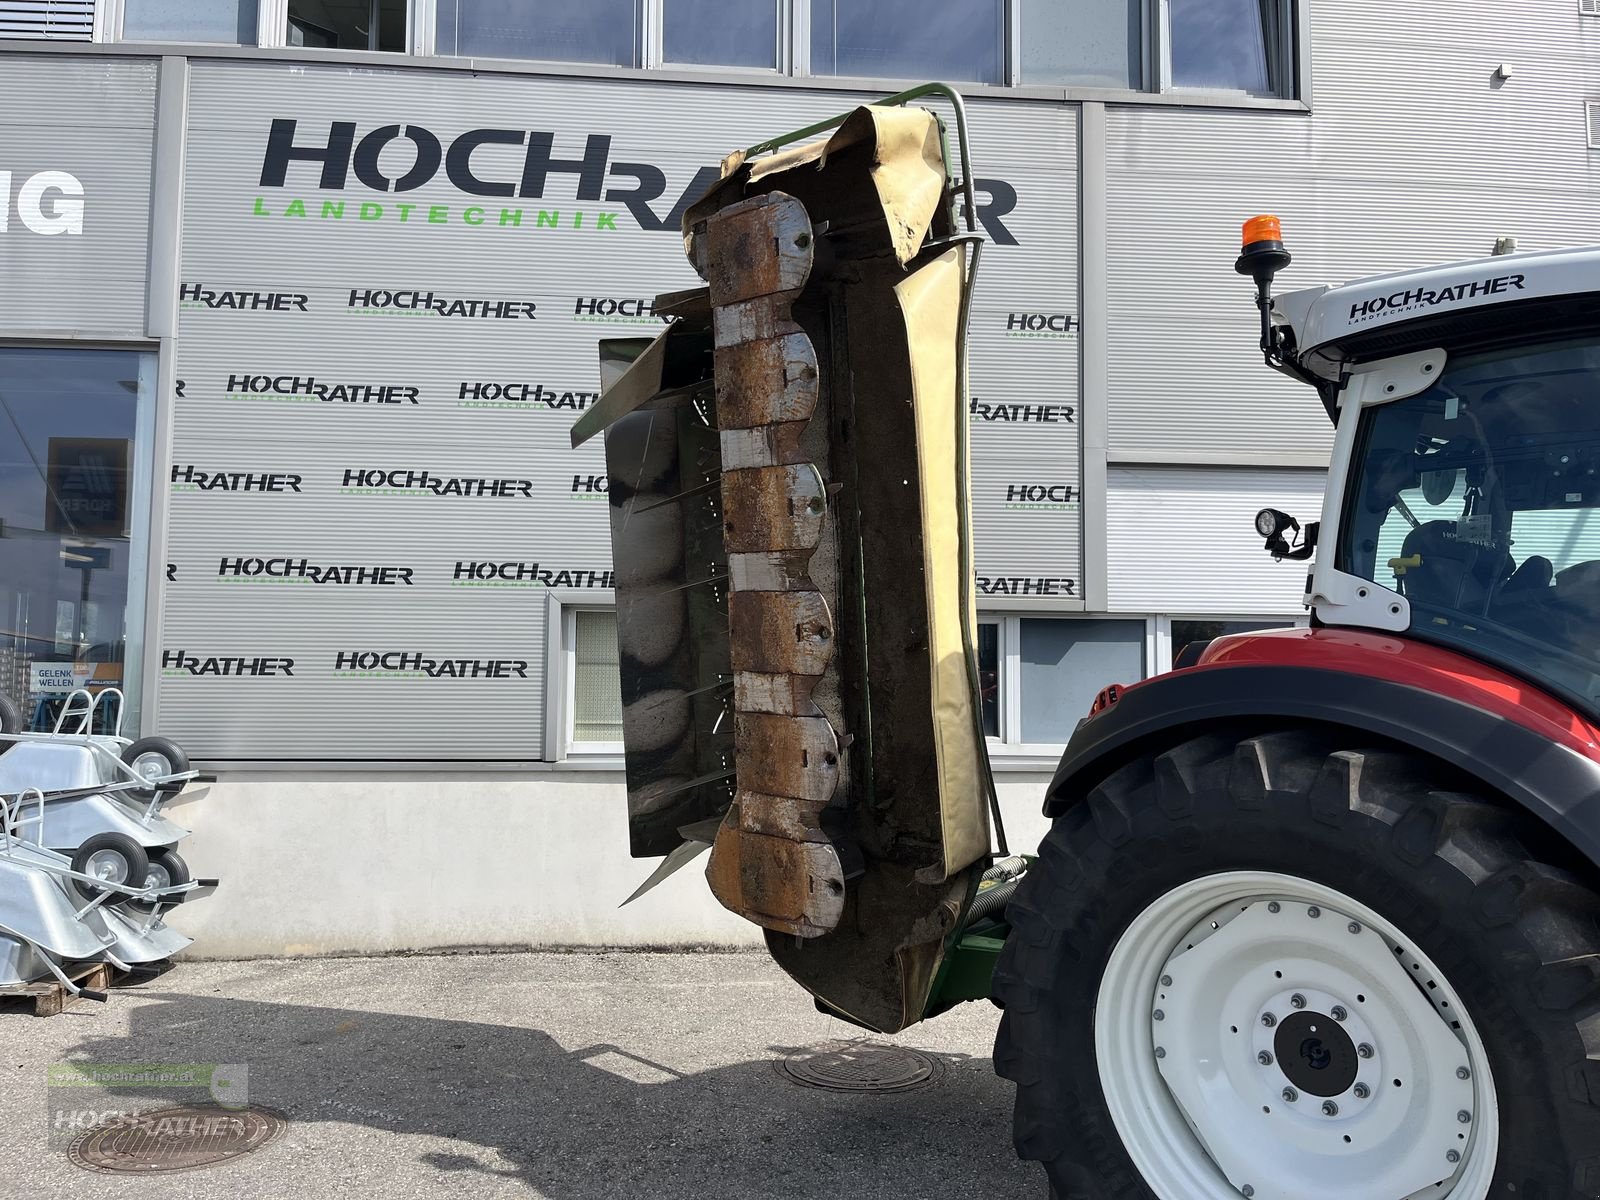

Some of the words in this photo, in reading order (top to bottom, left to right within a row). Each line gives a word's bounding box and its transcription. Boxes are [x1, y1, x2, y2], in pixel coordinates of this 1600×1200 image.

[253, 198, 619, 230] LANDTECHNIK
[348, 289, 537, 320] HOCHRATHER
[575, 297, 680, 324] HOCH
[1349, 274, 1526, 319] HOCHRATHER
[1348, 303, 1425, 325] LANDTECHNIK
[226, 375, 420, 405] HOCHRATHER
[342, 469, 533, 498] HOCHRATHER
[218, 557, 414, 586] HOCHRATHER
[975, 570, 1075, 596] RATHER
[39, 669, 72, 678] GELENK
[335, 651, 528, 678] HOCHRATHER
[39, 679, 74, 687] WELLEN
